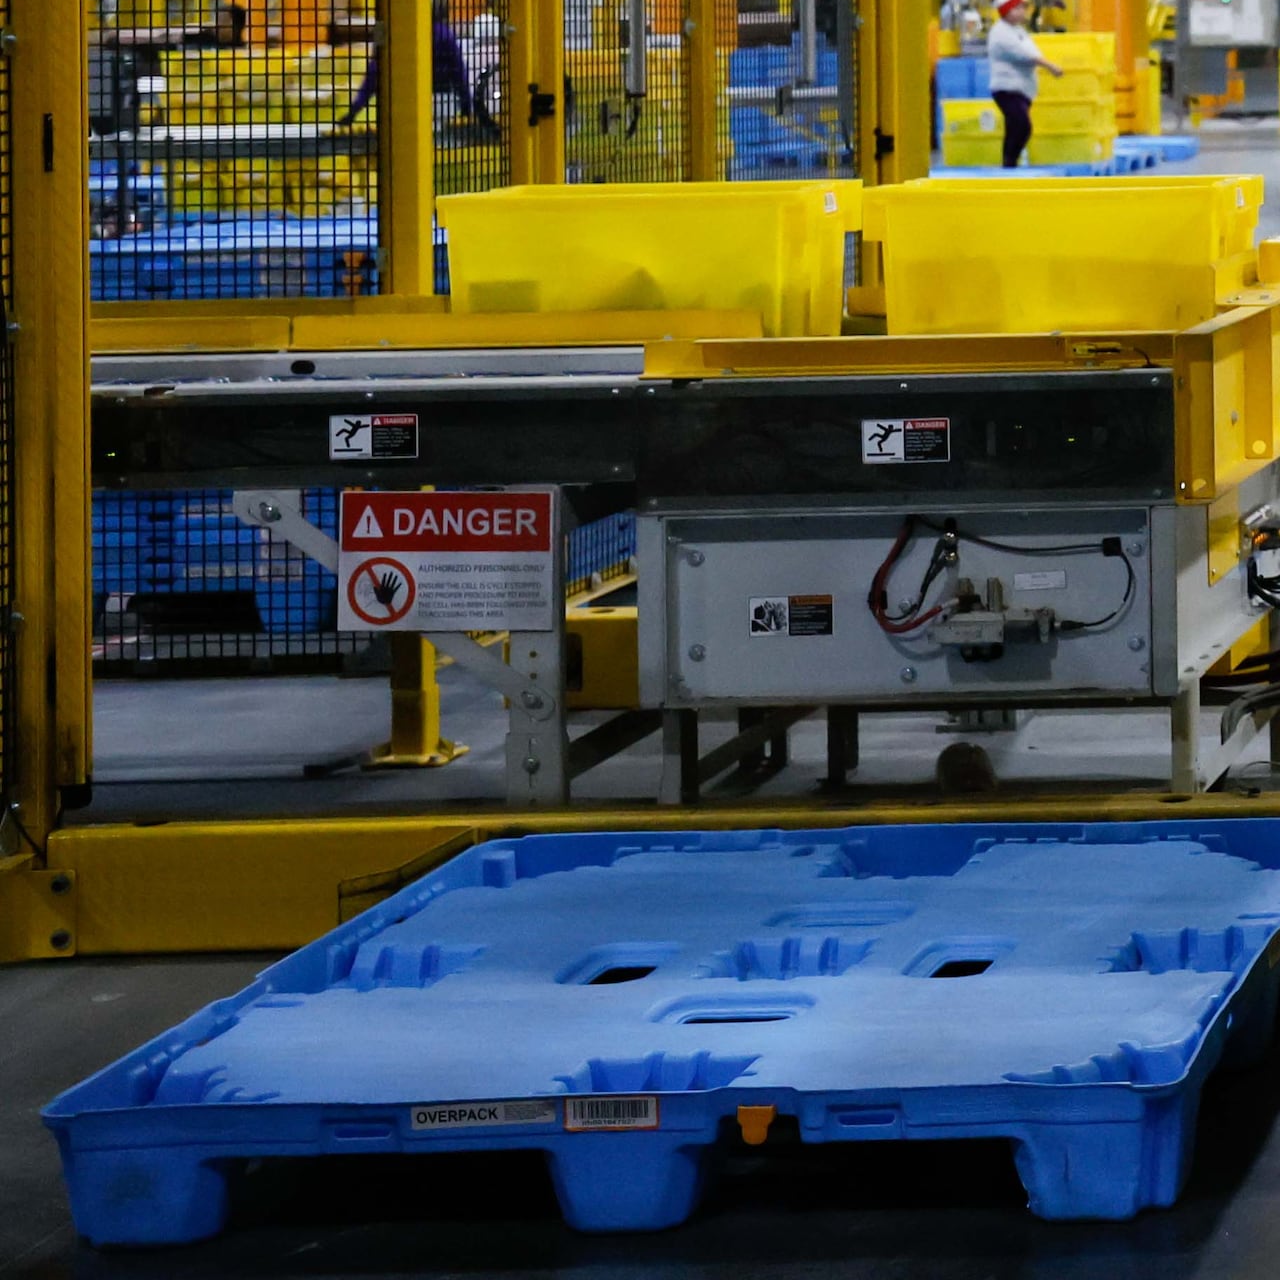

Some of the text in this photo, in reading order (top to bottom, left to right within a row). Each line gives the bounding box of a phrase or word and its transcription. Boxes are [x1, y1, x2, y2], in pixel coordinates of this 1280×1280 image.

[393, 508, 538, 536] DANGER
[418, 564, 472, 572] AUTHORIZED
[473, 564, 522, 573] PERSONNEL
[416, 1107, 498, 1124] OVERPACK
